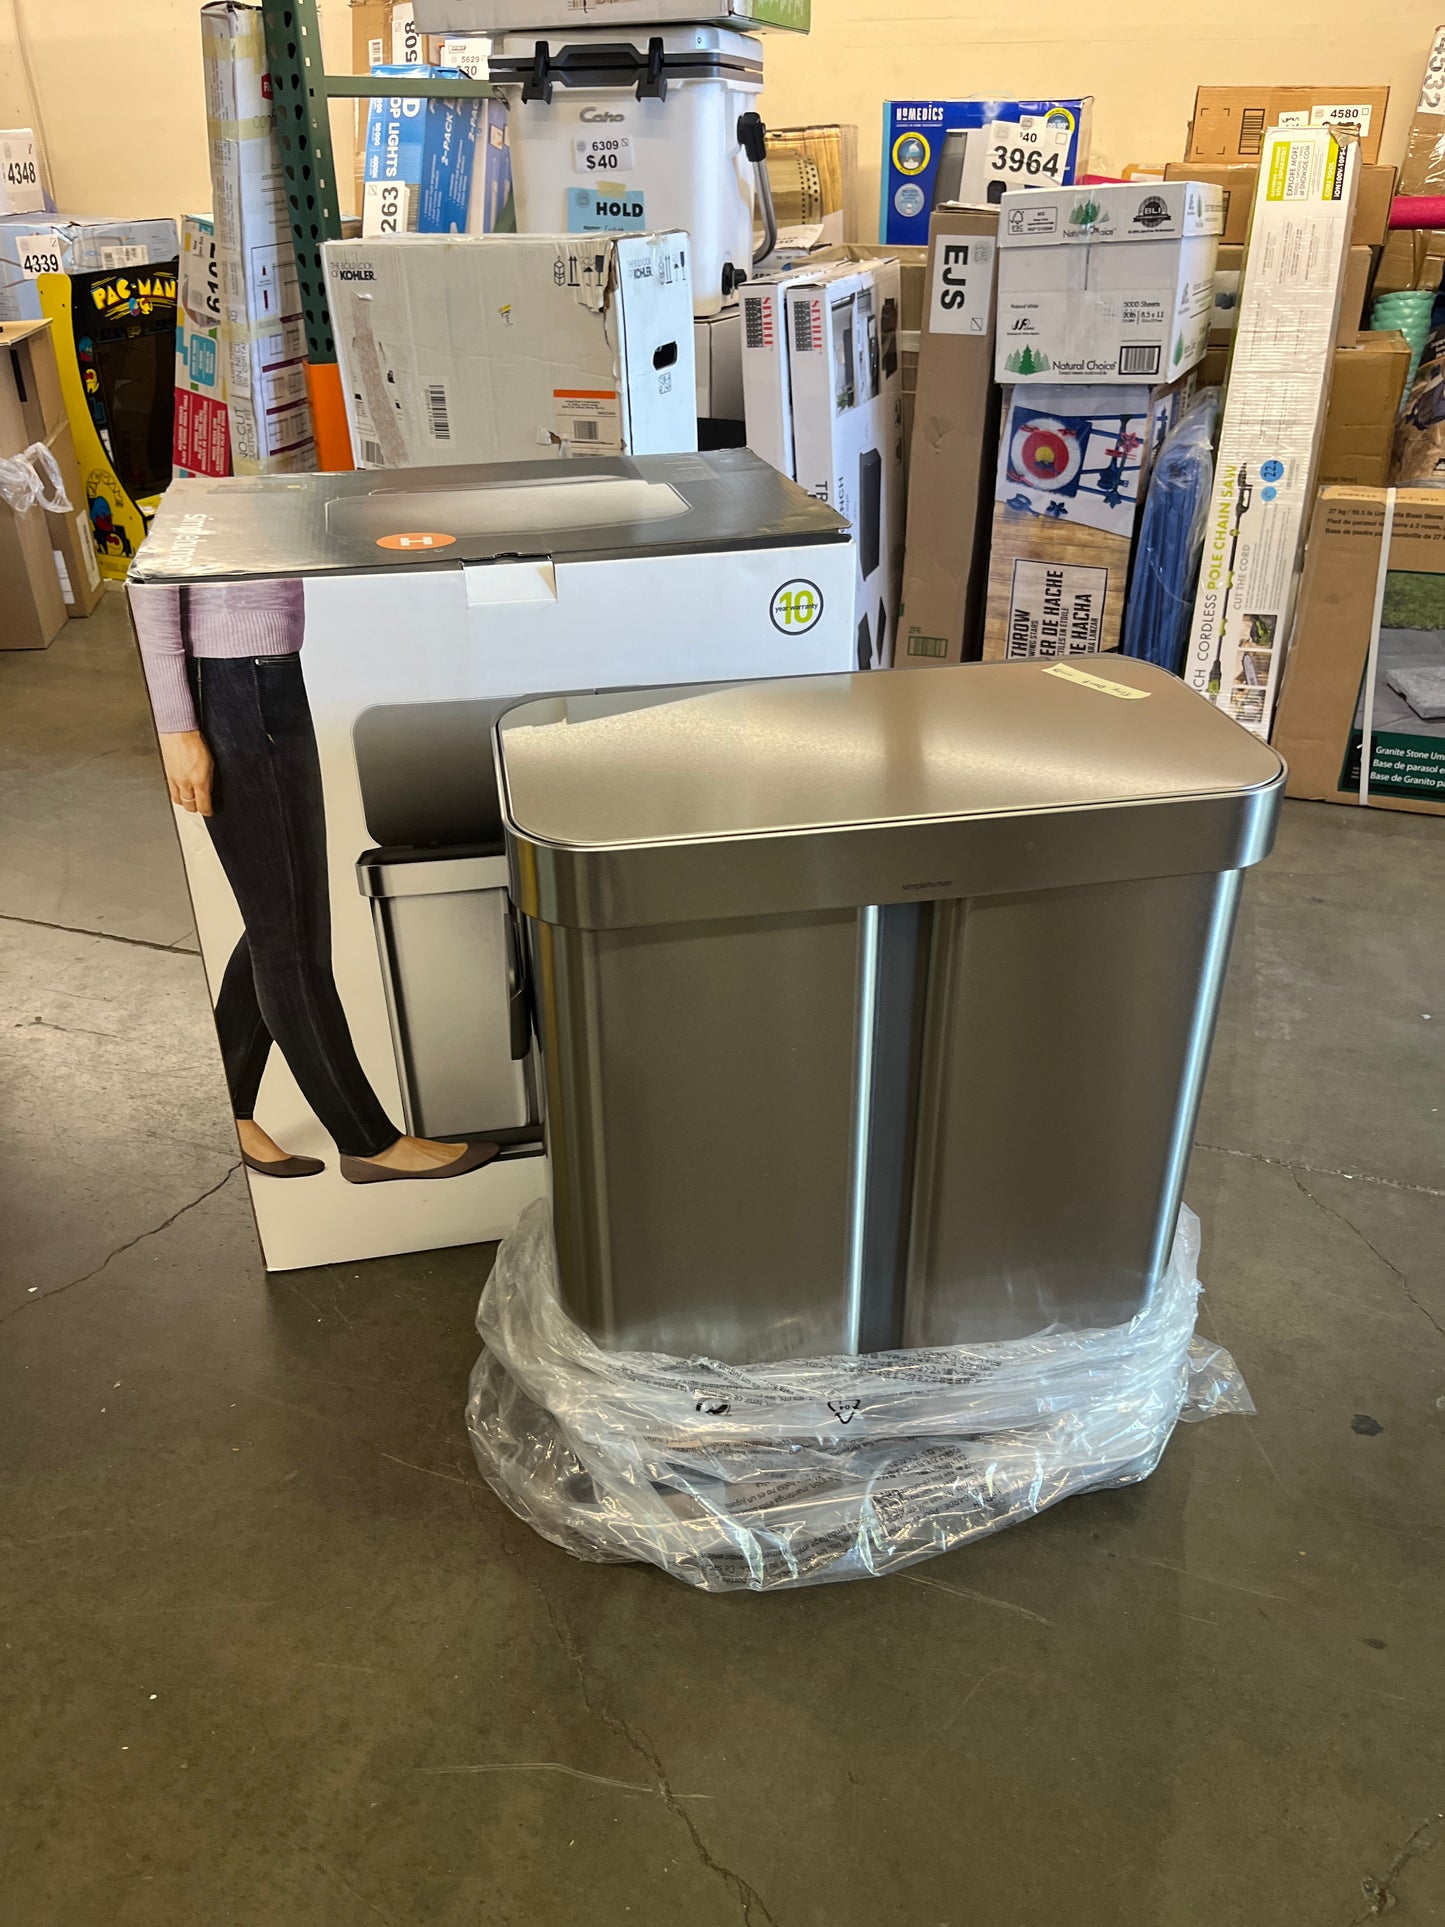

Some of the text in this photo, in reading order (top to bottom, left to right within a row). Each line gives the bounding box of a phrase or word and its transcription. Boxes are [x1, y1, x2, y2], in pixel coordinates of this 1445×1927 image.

[579, 106, 625, 123] Coho
[1330, 108, 1359, 119] 4580
[441, 112, 453, 166] 2-PACK
[592, 140, 619, 151] 6309
[1019, 132, 1038, 143] $40
[385, 122, 400, 177] LIGHTS
[586, 154, 618, 170] $40
[991, 145, 1060, 178] 3964
[1286, 145, 1299, 196] EXPLORE MORE
[1327, 162, 1335, 179] TOOL
[8, 162, 36, 185] 4348
[596, 202, 644, 218] HOLD
[24, 253, 59, 274] 4339
[340, 270, 375, 281] KOHLER
[940, 244, 969, 310] EJS
[91, 278, 177, 310] PAC-MAN
[1052, 361, 1084, 371] Natural
[1222, 465, 1238, 498] SAW
[1213, 502, 1232, 550] CHAIN
[1207, 553, 1223, 591] POLE
[1233, 544, 1250, 610] CUT THE CORD
[1043, 570, 1063, 616] HACHE
[775, 605, 789, 613] year
[779, 590, 813, 624] 10
[1071, 593, 1092, 640] HACHA
[1011, 609, 1030, 657] THROW
[1030, 620, 1039, 640] STARS
[1041, 619, 1059, 637] DE
[1059, 629, 1067, 637] EN
[1089, 617, 1099, 641] LANZAR
[1197, 593, 1217, 661] CORDLESS
[1376, 746, 1405, 757] Granite
[1406, 749, 1429, 759] Stone
[1373, 759, 1393, 767] Base
[1406, 764, 1438, 774] parasol
[1370, 771, 1390, 780] Base
[1391, 775, 1402, 783] de
[1404, 775, 1436, 786] Granito
